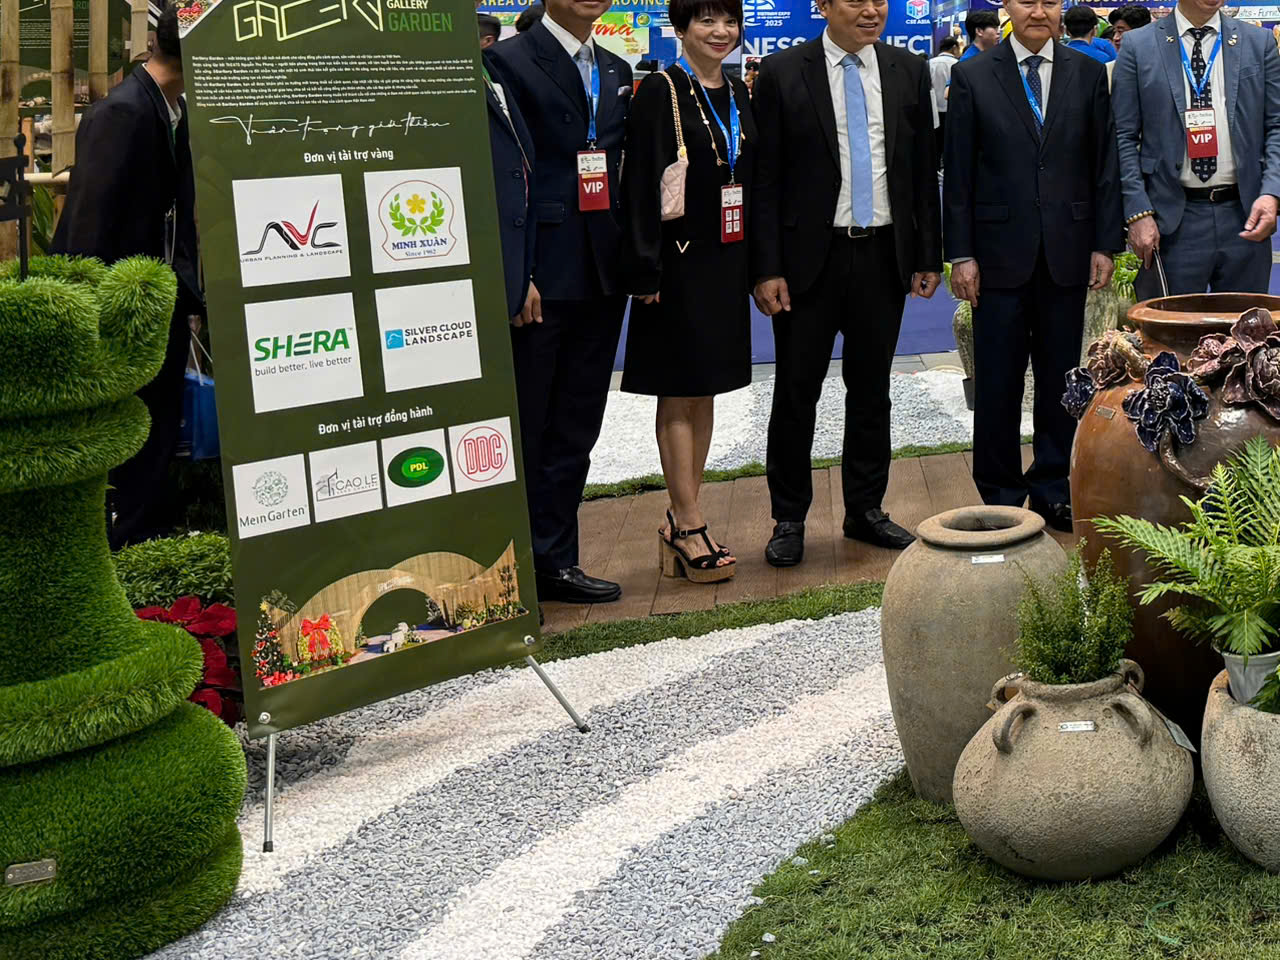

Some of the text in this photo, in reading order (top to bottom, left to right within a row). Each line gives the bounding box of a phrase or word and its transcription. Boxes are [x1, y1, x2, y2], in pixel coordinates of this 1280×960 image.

[386, 0, 429, 10] GALLERY
[388, 12, 453, 32] GARDEN
[1190, 133, 1212, 144] VIP
[303, 148, 394, 164] Đơn vị tài trợ vàng
[583, 181, 604, 194] VIP
[391, 237, 447, 250] MINH XUÂN
[265, 253, 298, 261] PLANNING
[306, 249, 343, 257] LANDSCAPE
[404, 320, 472, 337] SILVER CLOUD
[405, 329, 473, 346] LANDSCAPE
[255, 364, 276, 377] build
[309, 358, 324, 370] live
[325, 355, 352, 368] better
[318, 405, 433, 435] Đơn vị tài trợ đồng hành
[463, 433, 503, 475] DDC
[410, 461, 429, 473] PDL
[336, 477, 363, 491] CAO
[365, 473, 378, 485] LE
